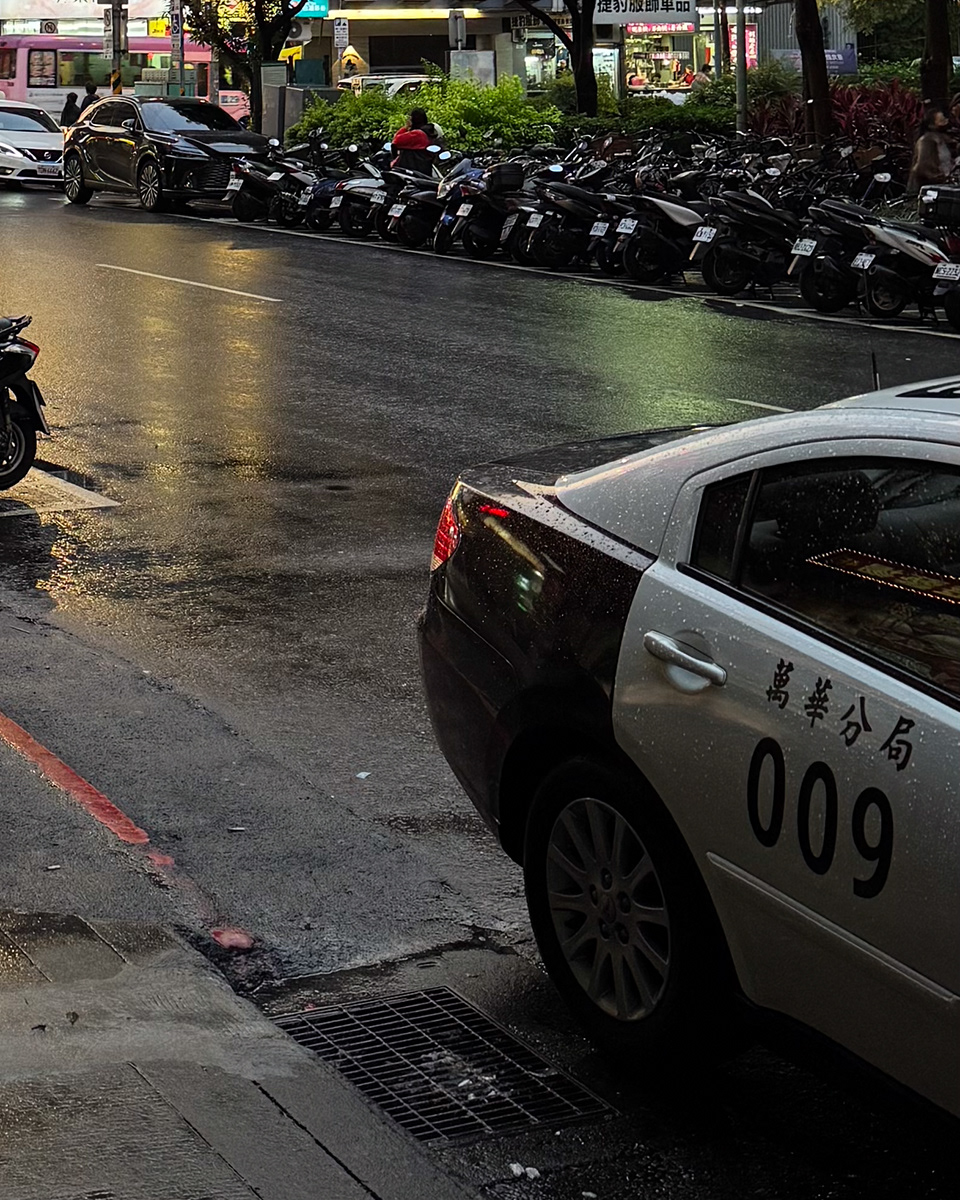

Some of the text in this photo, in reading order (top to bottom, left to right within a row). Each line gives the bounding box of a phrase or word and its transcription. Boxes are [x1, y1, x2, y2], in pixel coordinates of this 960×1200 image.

[765, 658, 916, 772] 萬華分局
[746, 736, 895, 899] 009
